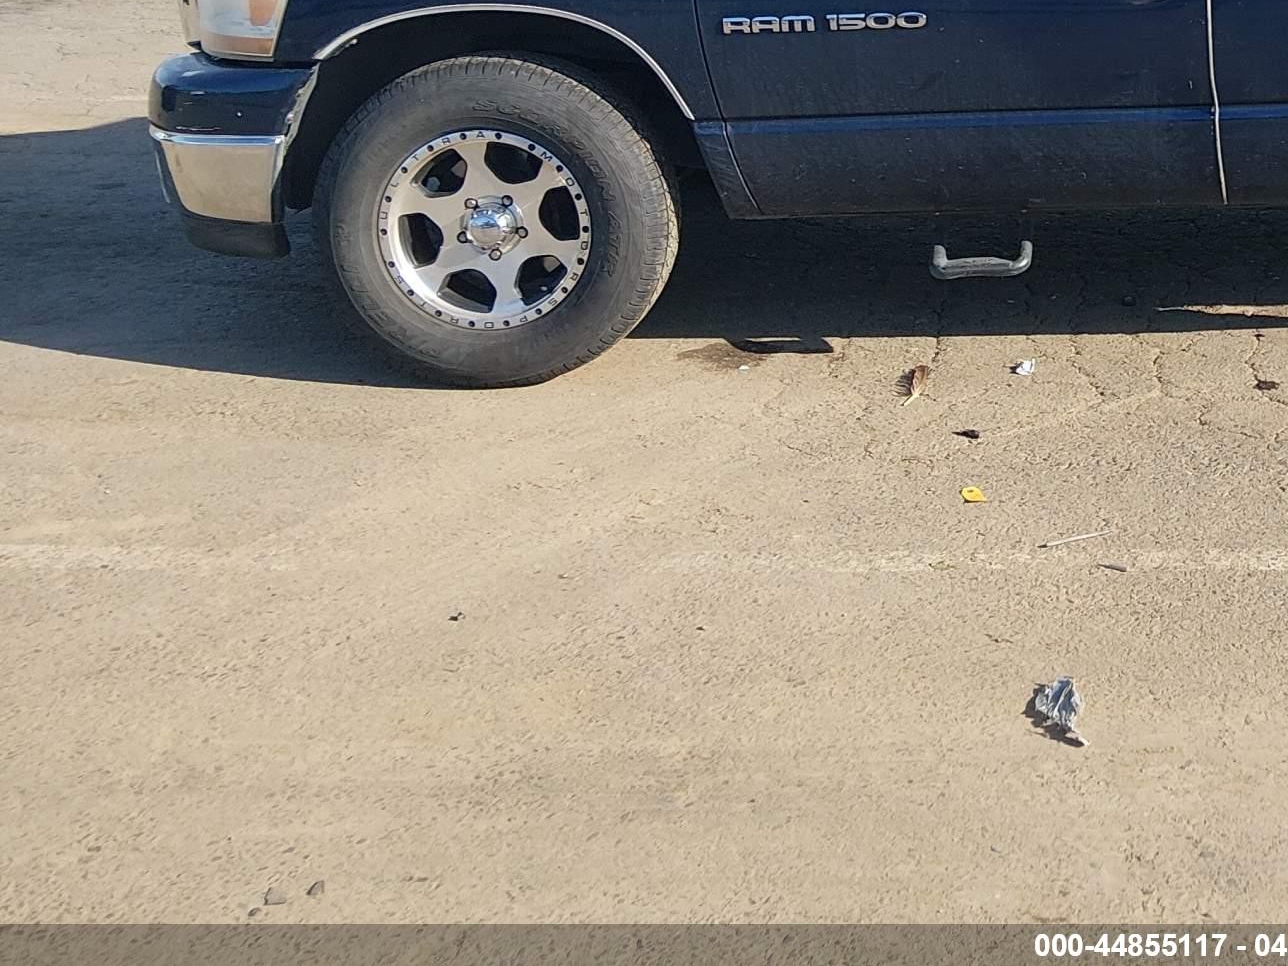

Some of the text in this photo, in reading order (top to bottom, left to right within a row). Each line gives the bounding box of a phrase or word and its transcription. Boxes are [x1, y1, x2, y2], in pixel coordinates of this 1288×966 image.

[722, 12, 927, 34] RAM 1500
[379, 131, 589, 329] ULTRA MOTORSPORTS
